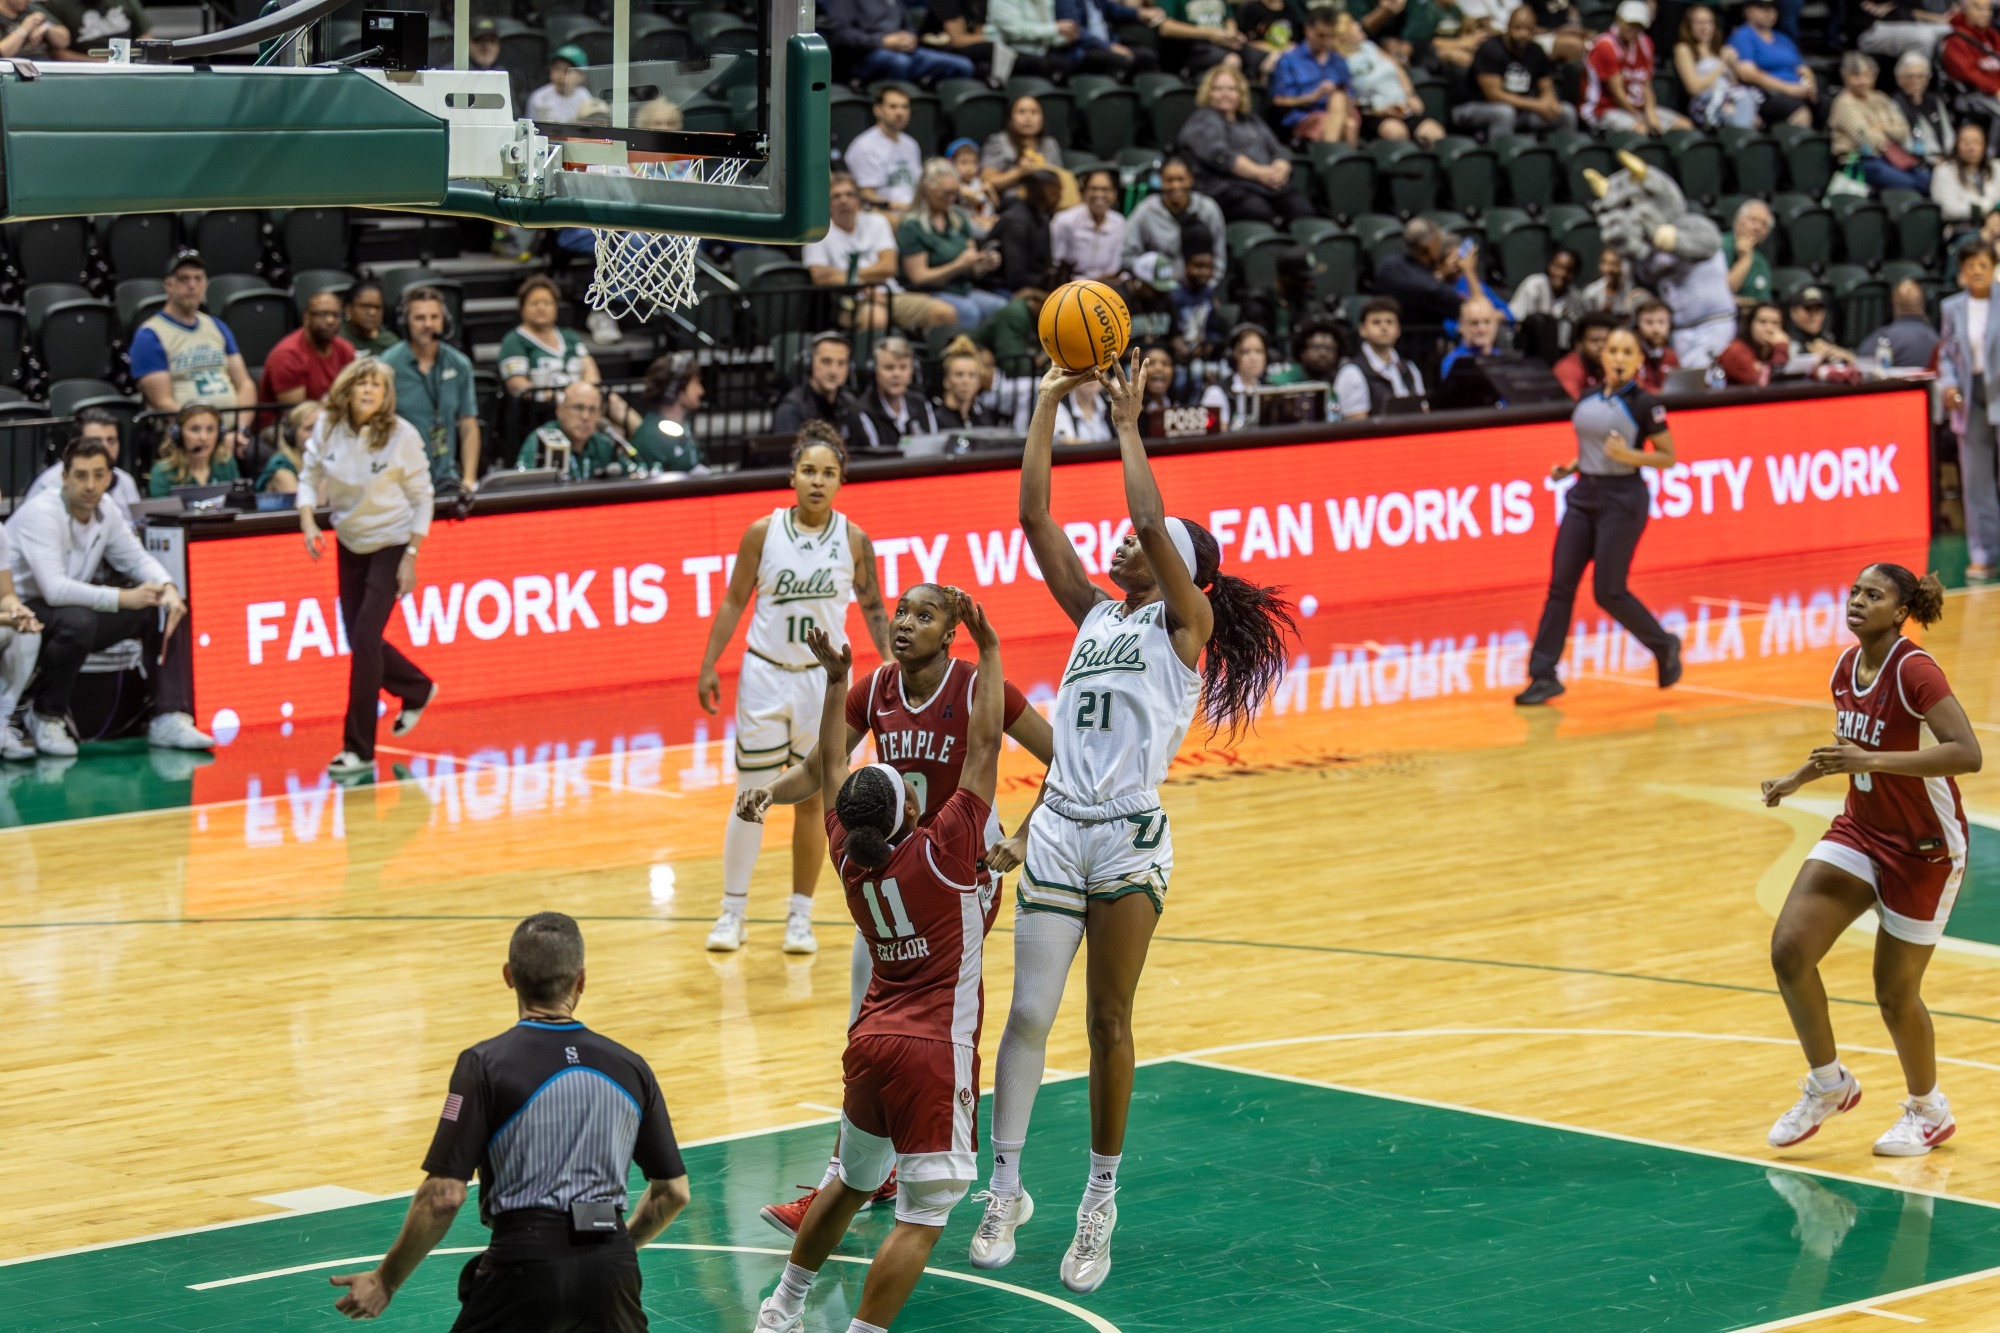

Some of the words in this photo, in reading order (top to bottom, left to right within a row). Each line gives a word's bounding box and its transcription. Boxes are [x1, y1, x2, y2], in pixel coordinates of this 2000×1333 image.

[1210, 502, 1312, 564] FAN
[1326, 485, 1482, 551] WORK
[1490, 489, 1534, 535] IS
[1765, 444, 1899, 504] WORK
[400, 569, 600, 647] WORK
[613, 563, 668, 626] IS
[772, 567, 836, 602] Bulls
[786, 615, 815, 643] 10
[1063, 631, 1145, 684] Bulls
[1076, 689, 1114, 731] 21
[1837, 710, 1885, 747] EMPLE
[879, 730, 955, 763] TEMPLE
[862, 877, 916, 938] 11
